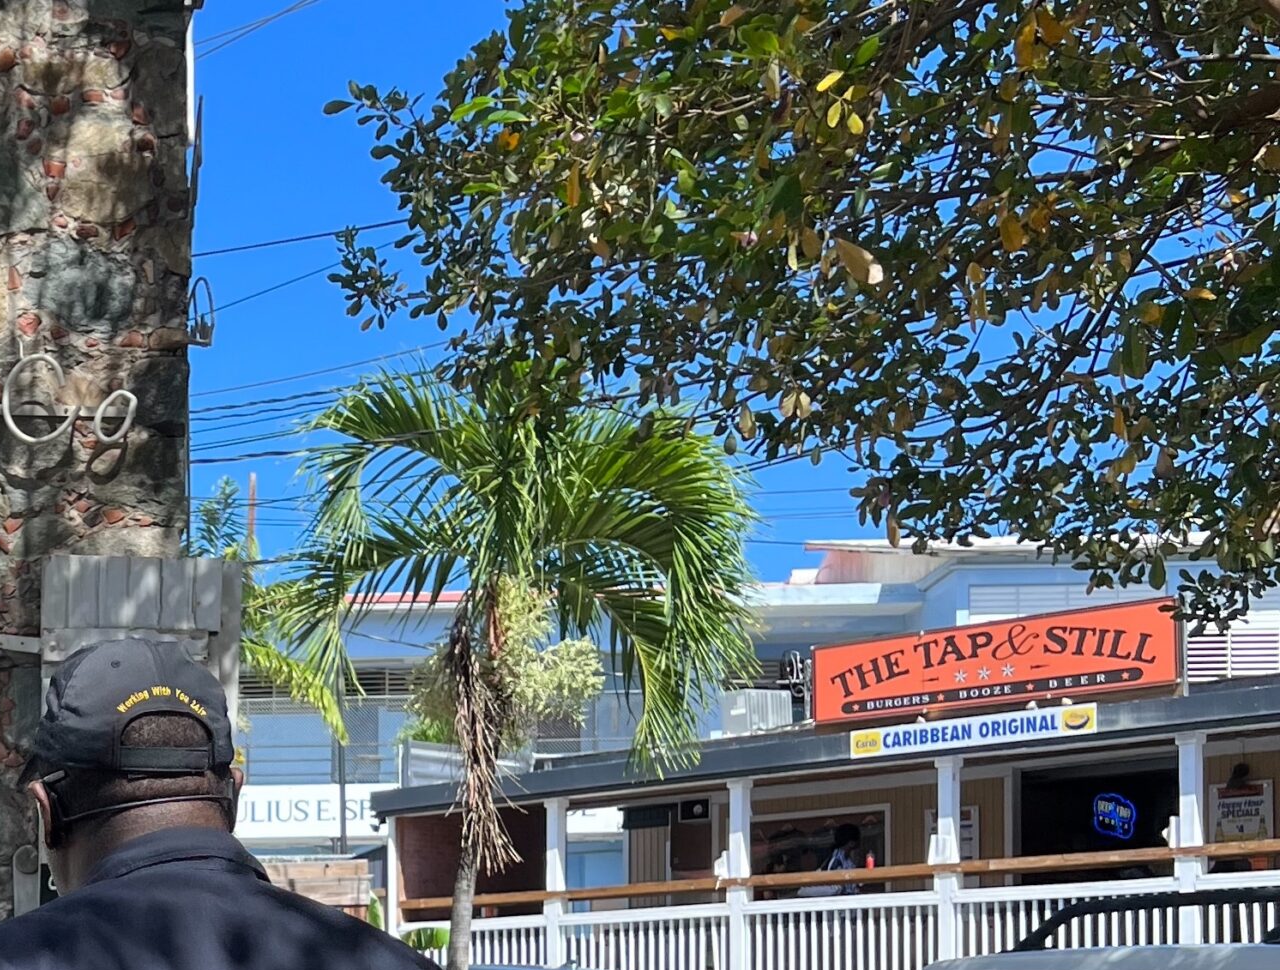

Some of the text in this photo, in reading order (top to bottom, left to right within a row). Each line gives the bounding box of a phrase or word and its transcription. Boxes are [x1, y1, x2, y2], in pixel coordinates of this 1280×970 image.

[1, 353, 139, 445] Co
[830, 624, 1157, 698] THE TAP & STILL
[116, 689, 150, 713] Working
[151, 685, 172, 696] With
[175, 688, 190, 705] You
[866, 673, 1106, 710] BURGERS BOOZE BEER
[882, 713, 1058, 749] CARIBBEAN ORIGINAL
[316, 799, 337, 821] E.
